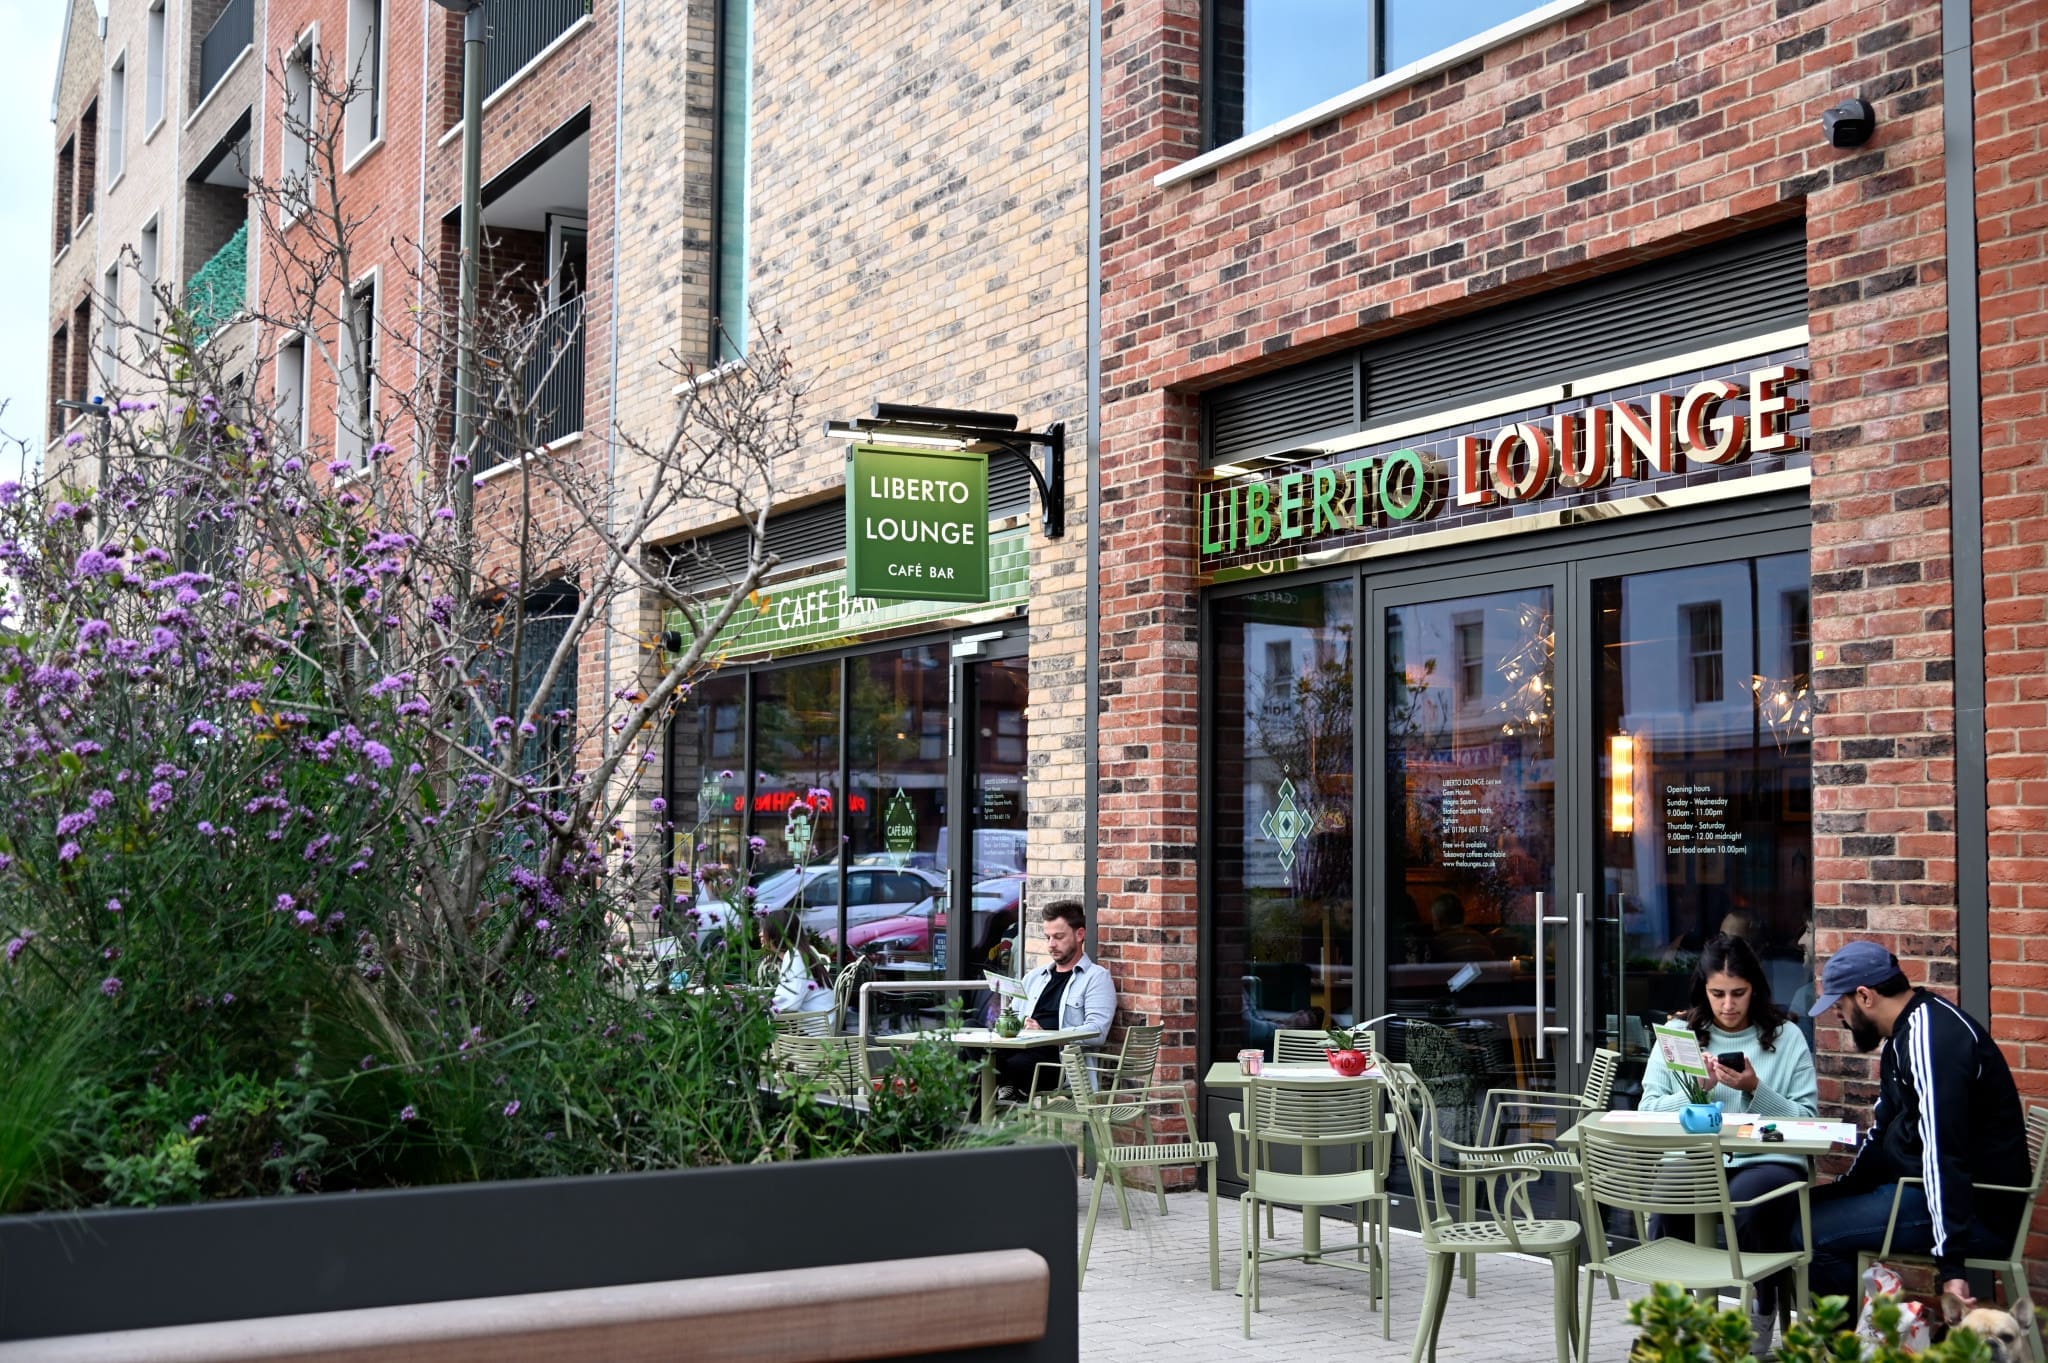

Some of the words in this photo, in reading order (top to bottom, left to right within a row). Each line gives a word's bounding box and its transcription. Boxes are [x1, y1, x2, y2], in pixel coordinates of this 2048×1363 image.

[1202, 449, 1424, 554] LIBERTO
[1457, 366, 1796, 506] LOUNGE
[870, 475, 969, 504] LIBERTO
[866, 517, 974, 545] LOUNGE
[888, 562, 922, 578] CAFÉ
[929, 566, 955, 580] BAR
[778, 589, 829, 630] CAFE
[1443, 779, 1462, 787] LIBERTO
[1463, 778, 1485, 786] LOUNGE
[1667, 784, 1693, 794] Opening
[1694, 784, 1711, 793] hours
[1667, 798, 1689, 808] Sunday
[1694, 797, 1729, 807] Wednesday
[1667, 808, 1690, 817] 9.00am
[1696, 808, 1723, 818] 11.00pm
[901, 825, 913, 837] BAR
[1667, 821, 1693, 831] Thursday
[1698, 821, 1726, 831] Saturday
[1667, 832, 1690, 841] 9.00am
[1696, 832, 1714, 840] 12.00
[1714, 831, 1742, 842] midnight
[1465, 840, 1487, 848] available
[1682, 845, 1696, 854] food
[1697, 845, 1716, 854] orders
[1443, 850, 1465, 859] Takeaway
[1466, 850, 1483, 858] coffees
[1484, 850, 1506, 858] available
